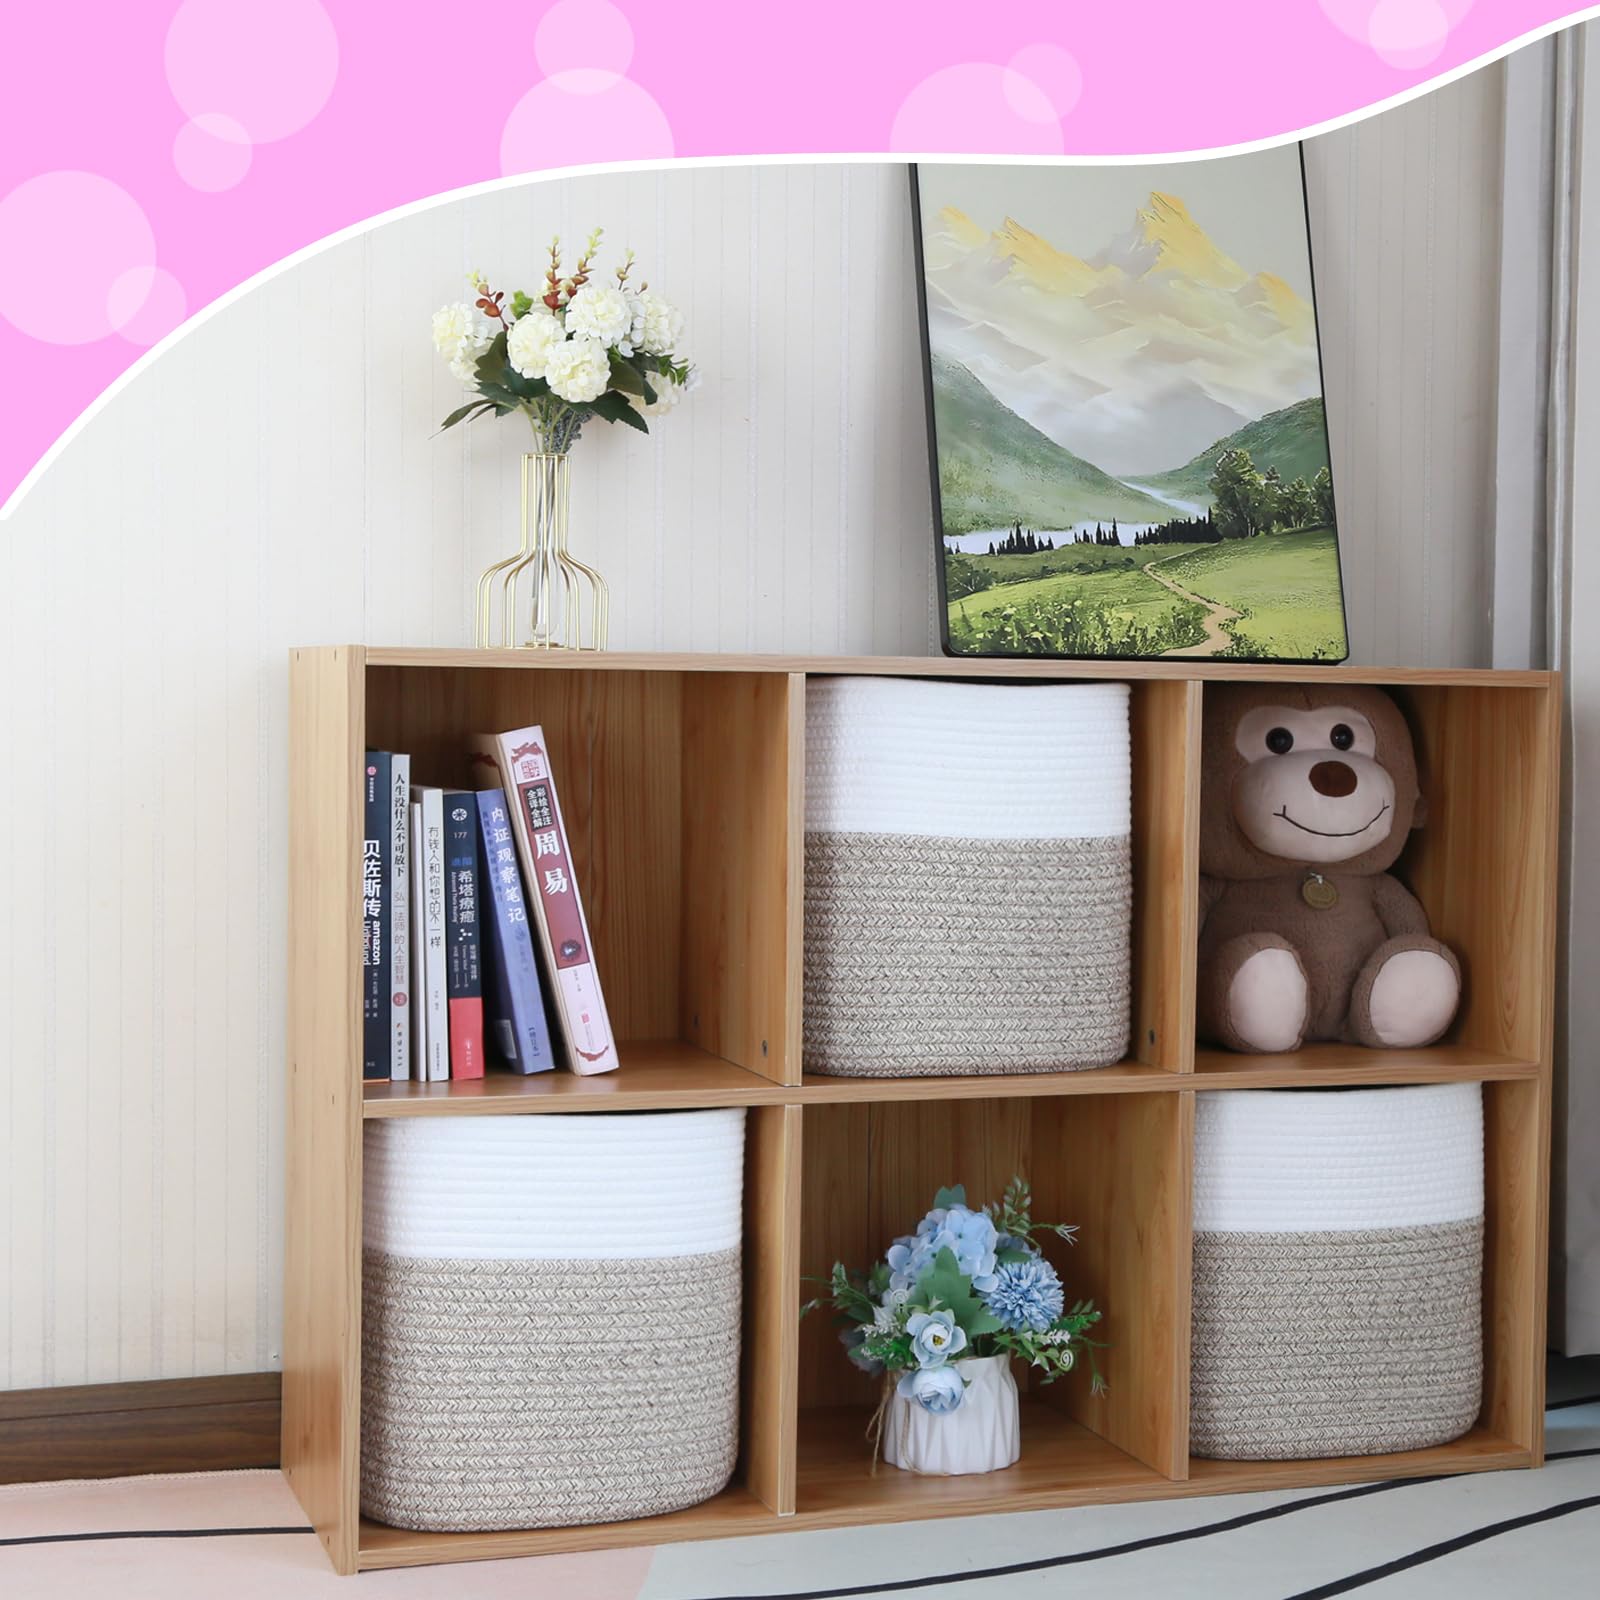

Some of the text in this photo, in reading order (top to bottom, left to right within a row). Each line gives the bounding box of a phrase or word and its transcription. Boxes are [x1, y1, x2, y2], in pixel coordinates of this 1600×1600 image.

[394, 773, 406, 878] 人生没什么不可放下
[453, 831, 468, 839] 177
[534, 829, 568, 896] 周易
[363, 840, 382, 917] 贝佐斯传
[427, 826, 441, 948] 有钱人和你想的不一样
[491, 807, 526, 923] 内证观察笔记
[372, 920, 381, 966] amazon
